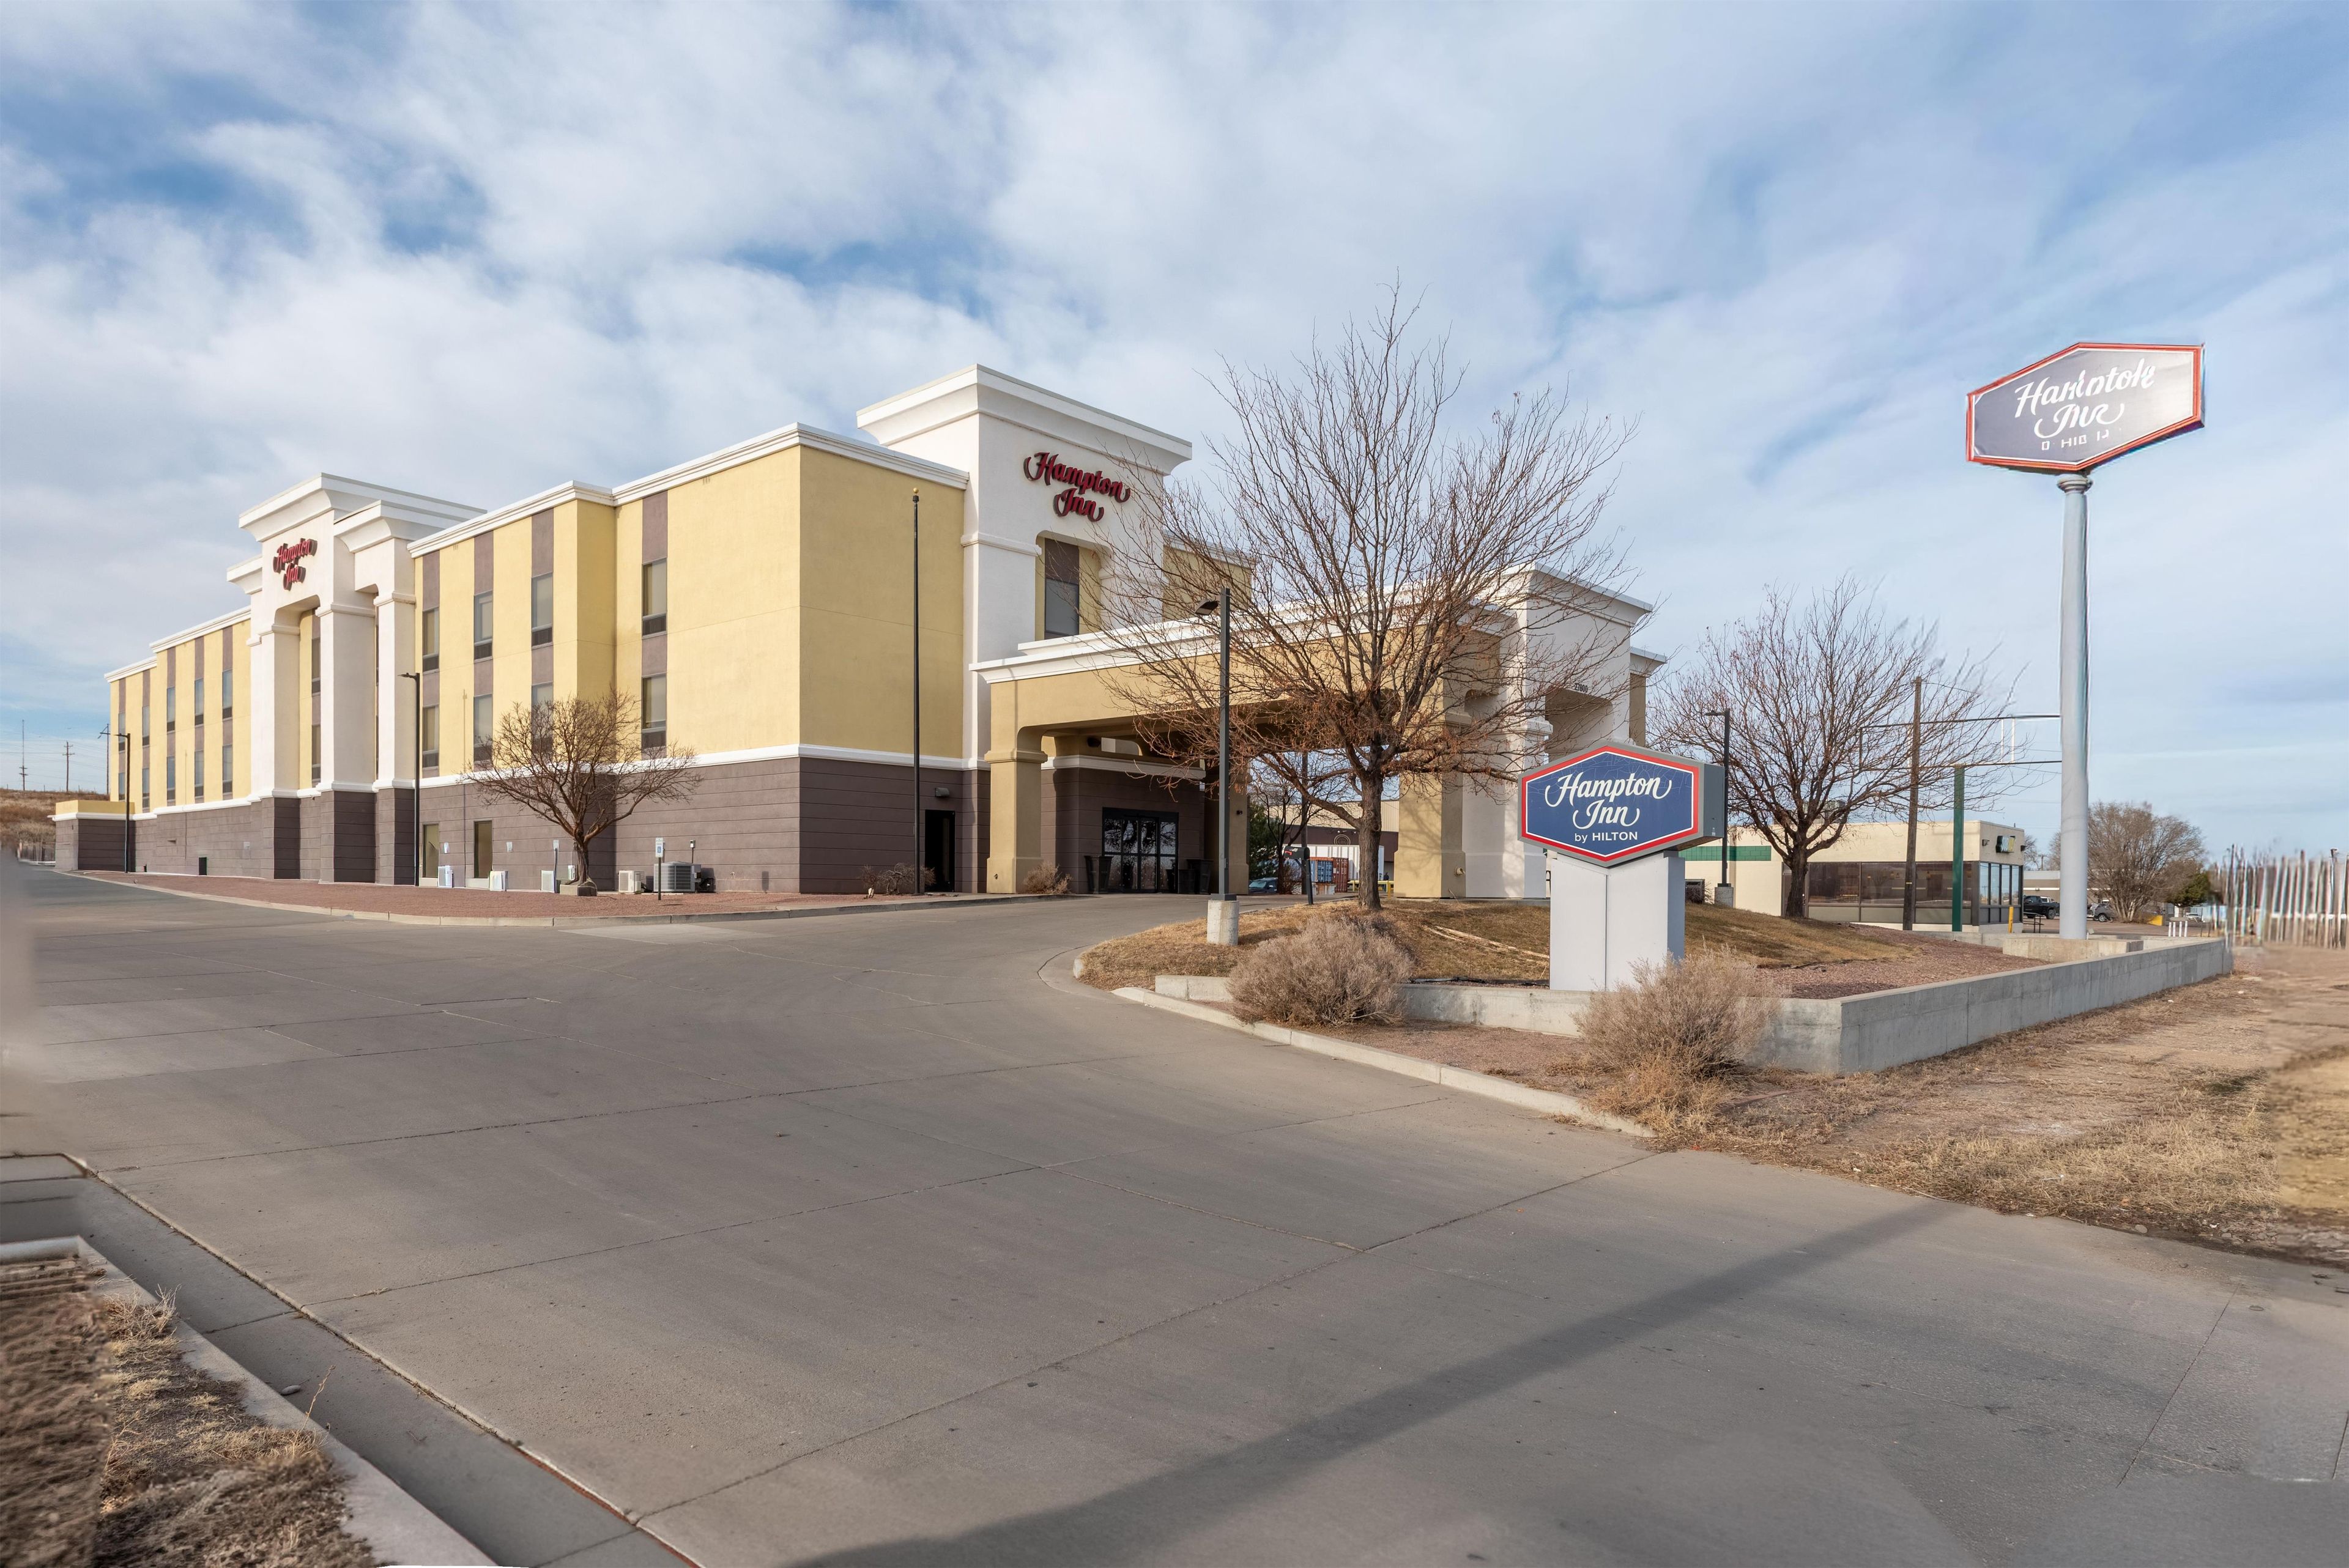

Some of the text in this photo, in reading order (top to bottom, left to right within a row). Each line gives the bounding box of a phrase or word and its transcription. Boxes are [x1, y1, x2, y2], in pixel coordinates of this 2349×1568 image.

[1023, 452, 1131, 503] Hampton
[1053, 488, 1105, 522] Inn
[1545, 771, 1672, 808] Hampton
[1572, 799, 1640, 830] Inn
[1574, 831, 1638, 843] by HILTON
